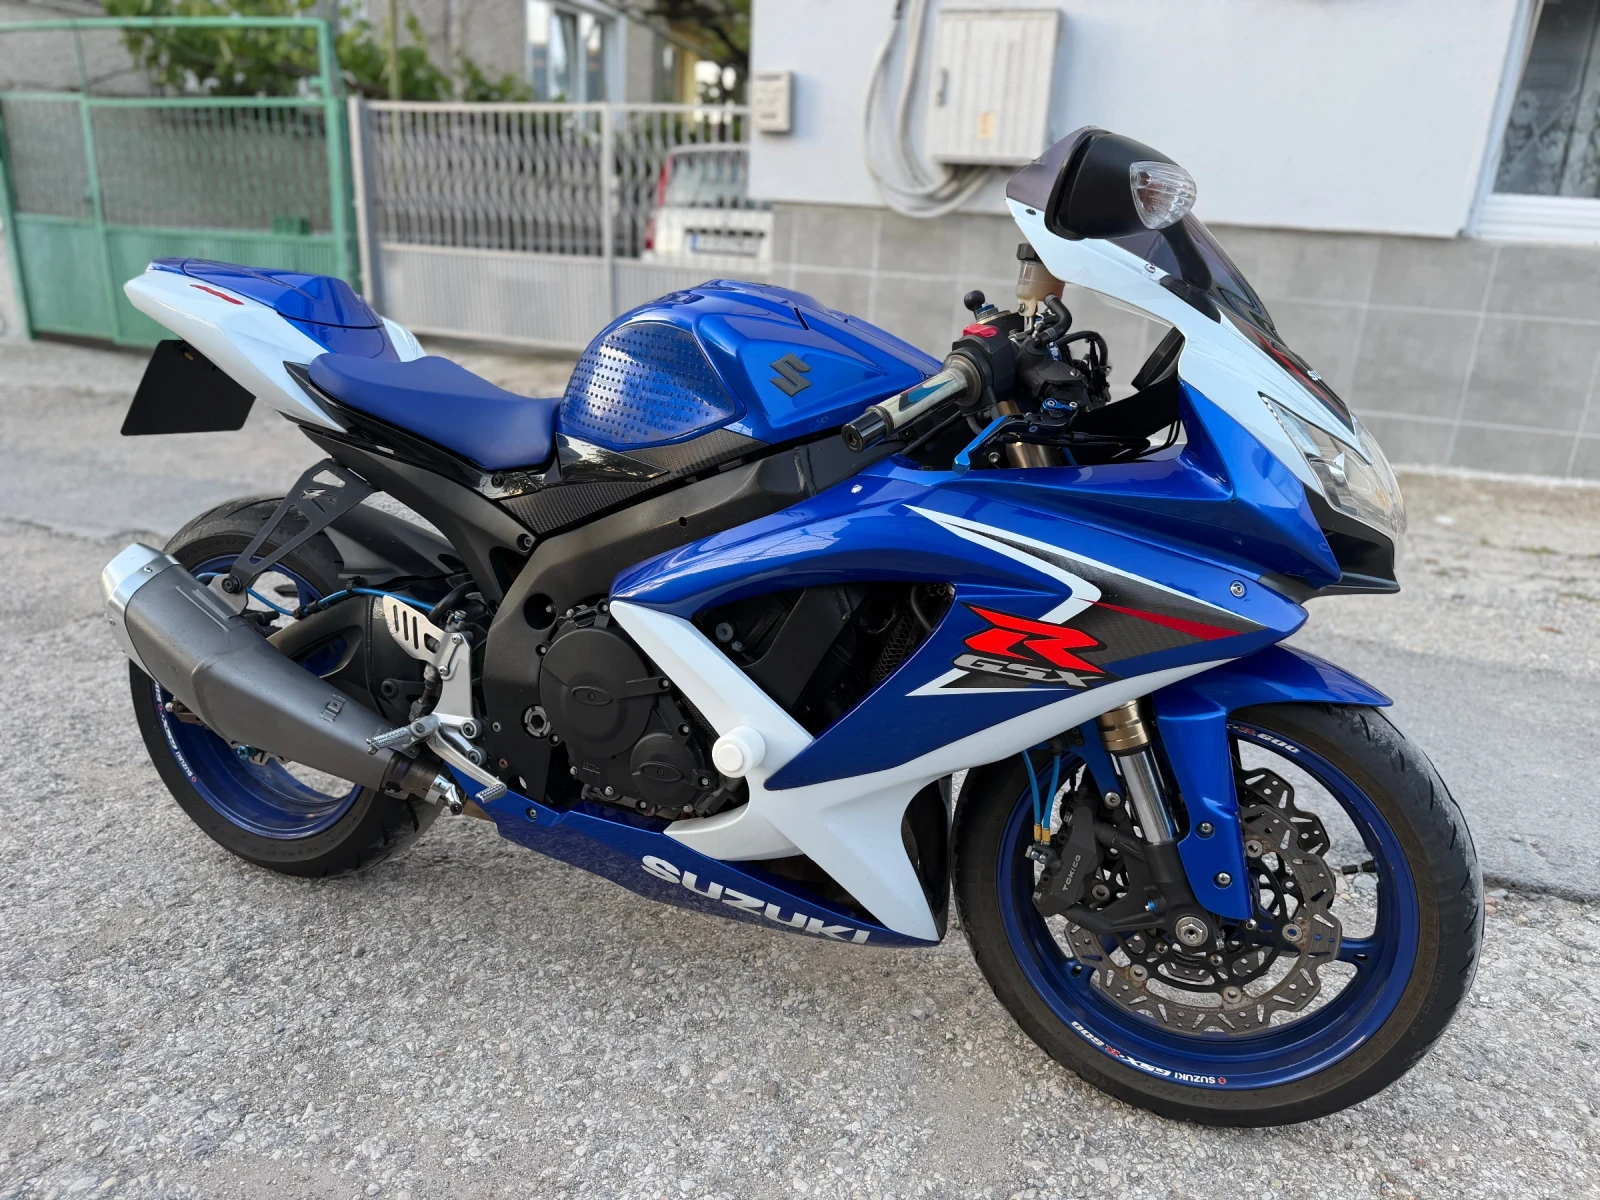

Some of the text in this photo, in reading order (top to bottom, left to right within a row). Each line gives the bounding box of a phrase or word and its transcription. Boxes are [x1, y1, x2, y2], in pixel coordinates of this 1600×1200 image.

[953, 653, 1105, 688] GSX
[1257, 732, 1300, 754] 600
[175, 750, 194, 777] SUZUKI
[1062, 854, 1082, 892] TOKICO
[641, 855, 871, 944] SUZUKI
[1071, 1020, 1105, 1047] 600
[1174, 1071, 1216, 1084] SUZUKI
